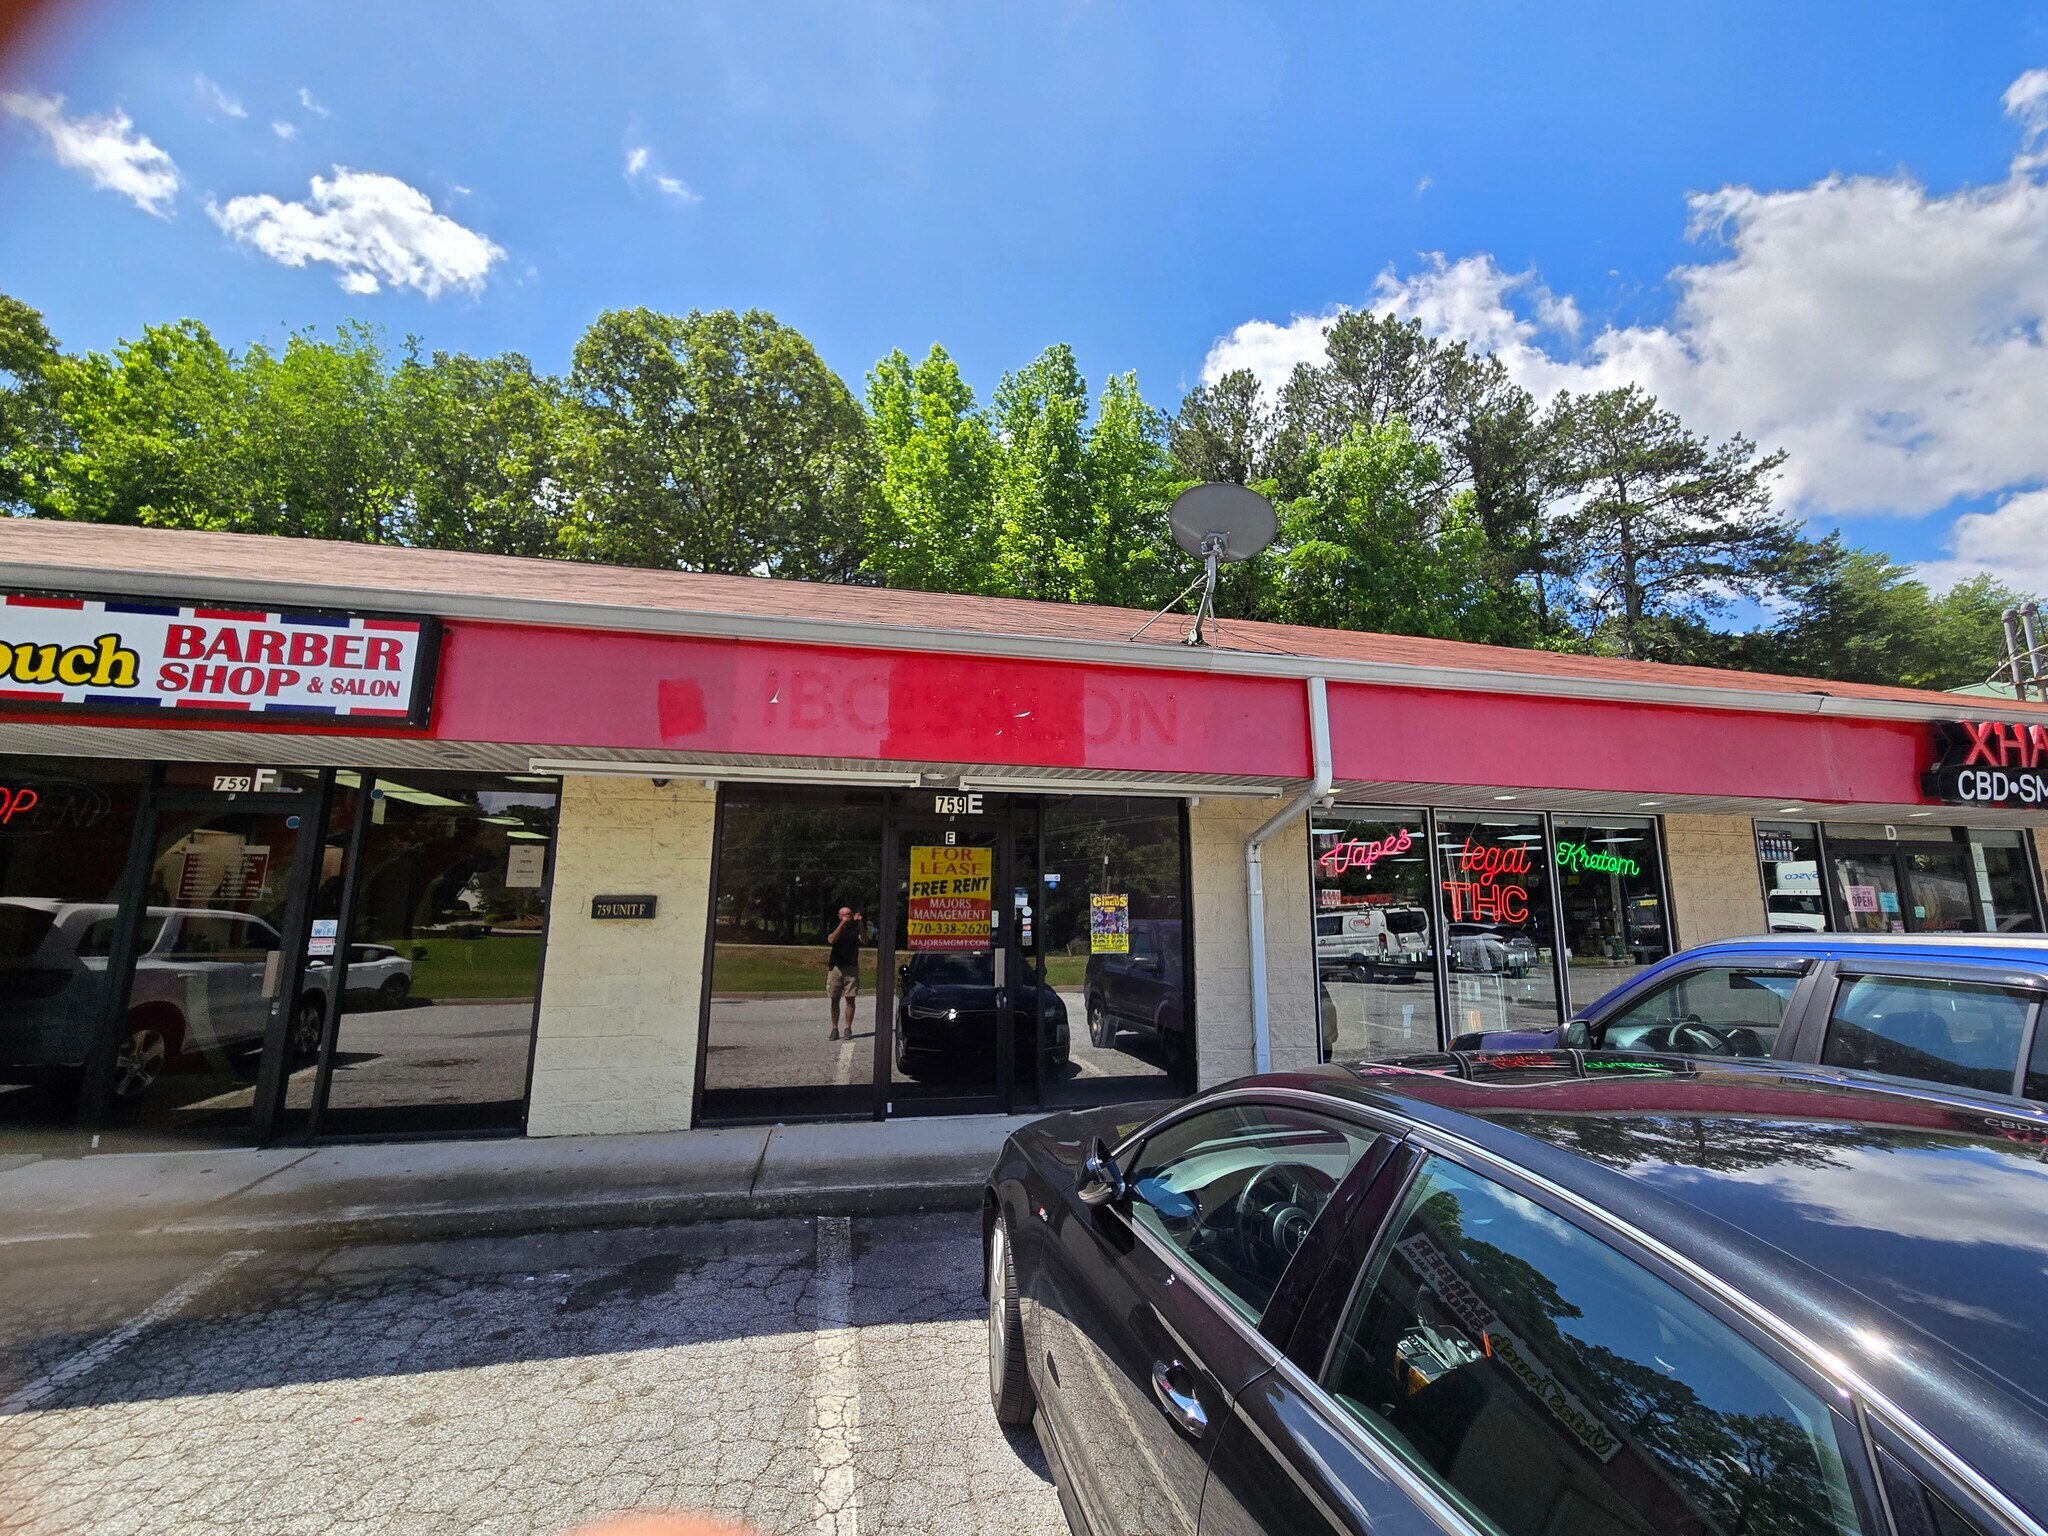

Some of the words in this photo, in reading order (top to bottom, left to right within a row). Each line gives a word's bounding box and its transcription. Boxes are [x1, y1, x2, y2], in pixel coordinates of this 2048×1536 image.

[163, 624, 403, 671] BARBER
[156, 662, 301, 697] SHOP
[306, 676, 324, 695] &
[329, 677, 401, 698] SALON
[215, 777, 249, 791] 759
[253, 768, 277, 792] F
[937, 796, 965, 813] 759
[968, 794, 983, 814] E
[946, 833, 955, 844] E
[1885, 825, 1896, 840] D
[931, 847, 973, 861] FOR
[1320, 828, 1412, 873] Vapes
[1556, 841, 1640, 876] Kratom
[920, 861, 983, 875] LEASE
[912, 880, 949, 896] FREE
[952, 877, 990, 894] RENT
[930, 898, 972, 909] MAJORS
[1442, 881, 1529, 923] THC
[1851, 895, 1874, 908] OPEN
[597, 904, 612, 916] 759
[612, 904, 638, 916] UNIT
[639, 904, 646, 916] F
[913, 909, 987, 920] MANAGEMENT
[911, 923, 990, 934] 770-338-2620
[910, 938, 989, 947] MAJORSMGMT.COM
